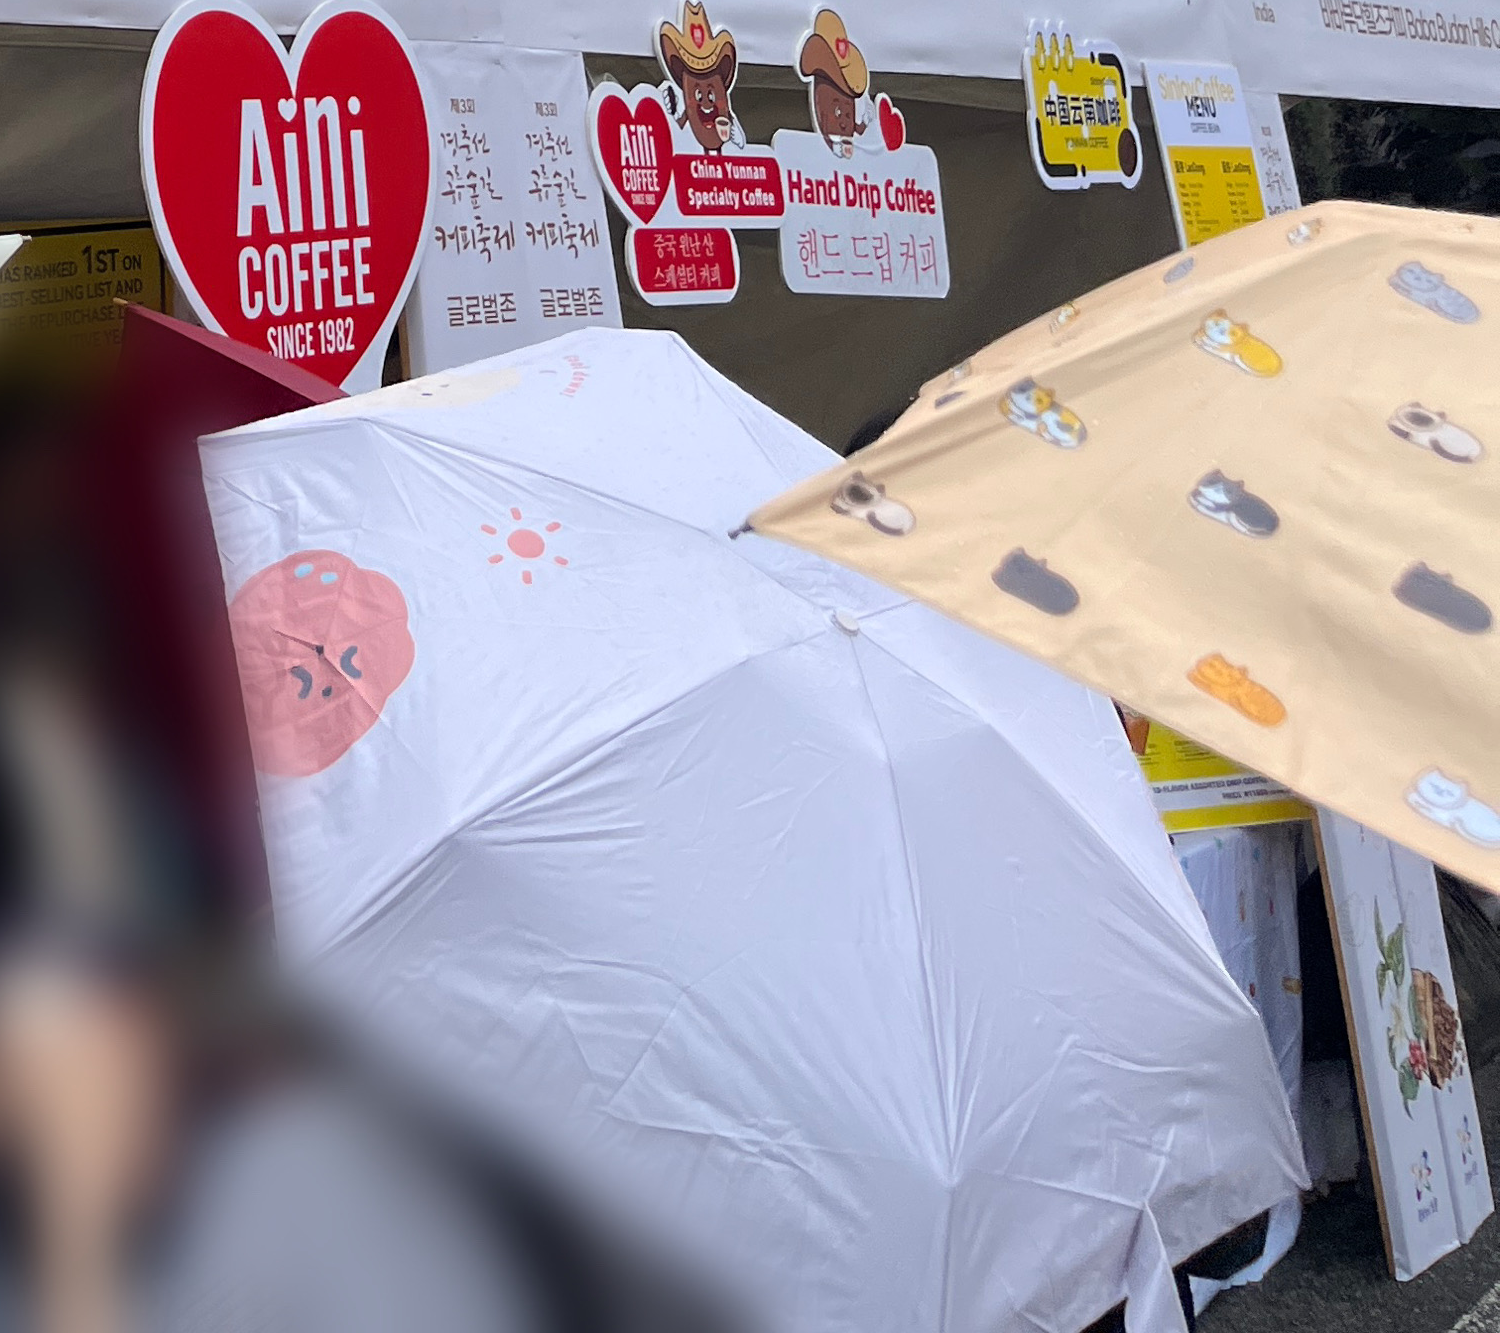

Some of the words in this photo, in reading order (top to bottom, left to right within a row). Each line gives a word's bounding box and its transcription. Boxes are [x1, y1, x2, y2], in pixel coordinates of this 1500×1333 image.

[1185, 94, 1218, 118] MENU
[236, 95, 370, 237] Aini
[621, 168, 661, 192] COFFEE
[689, 158, 723, 179] China
[724, 161, 767, 180] Yunnan
[687, 186, 740, 210] Specialty
[742, 187, 776, 206] Coffee
[786, 169, 841, 207] Hand
[843, 172, 882, 219] Drip
[884, 178, 936, 215] Coffee
[434, 215, 517, 264] 커피축제
[524, 212, 600, 259] 커피축제
[653, 233, 677, 258] 중국
[82, 245, 120, 275] 1ST
[122, 255, 142, 271] ON
[796, 228, 845, 279] 핸드
[850, 231, 893, 284] 드립
[899, 233, 939, 286] 커피
[87, 281, 112, 300] LIST
[116, 278, 143, 296] AND
[238, 236, 375, 320] COFFEE
[699, 262, 722, 287] 커피
[446, 291, 517, 327] 글로벌존
[539, 287, 604, 318] 글로벌존
[266, 321, 315, 360] SINCE
[317, 316, 356, 355] 1982
